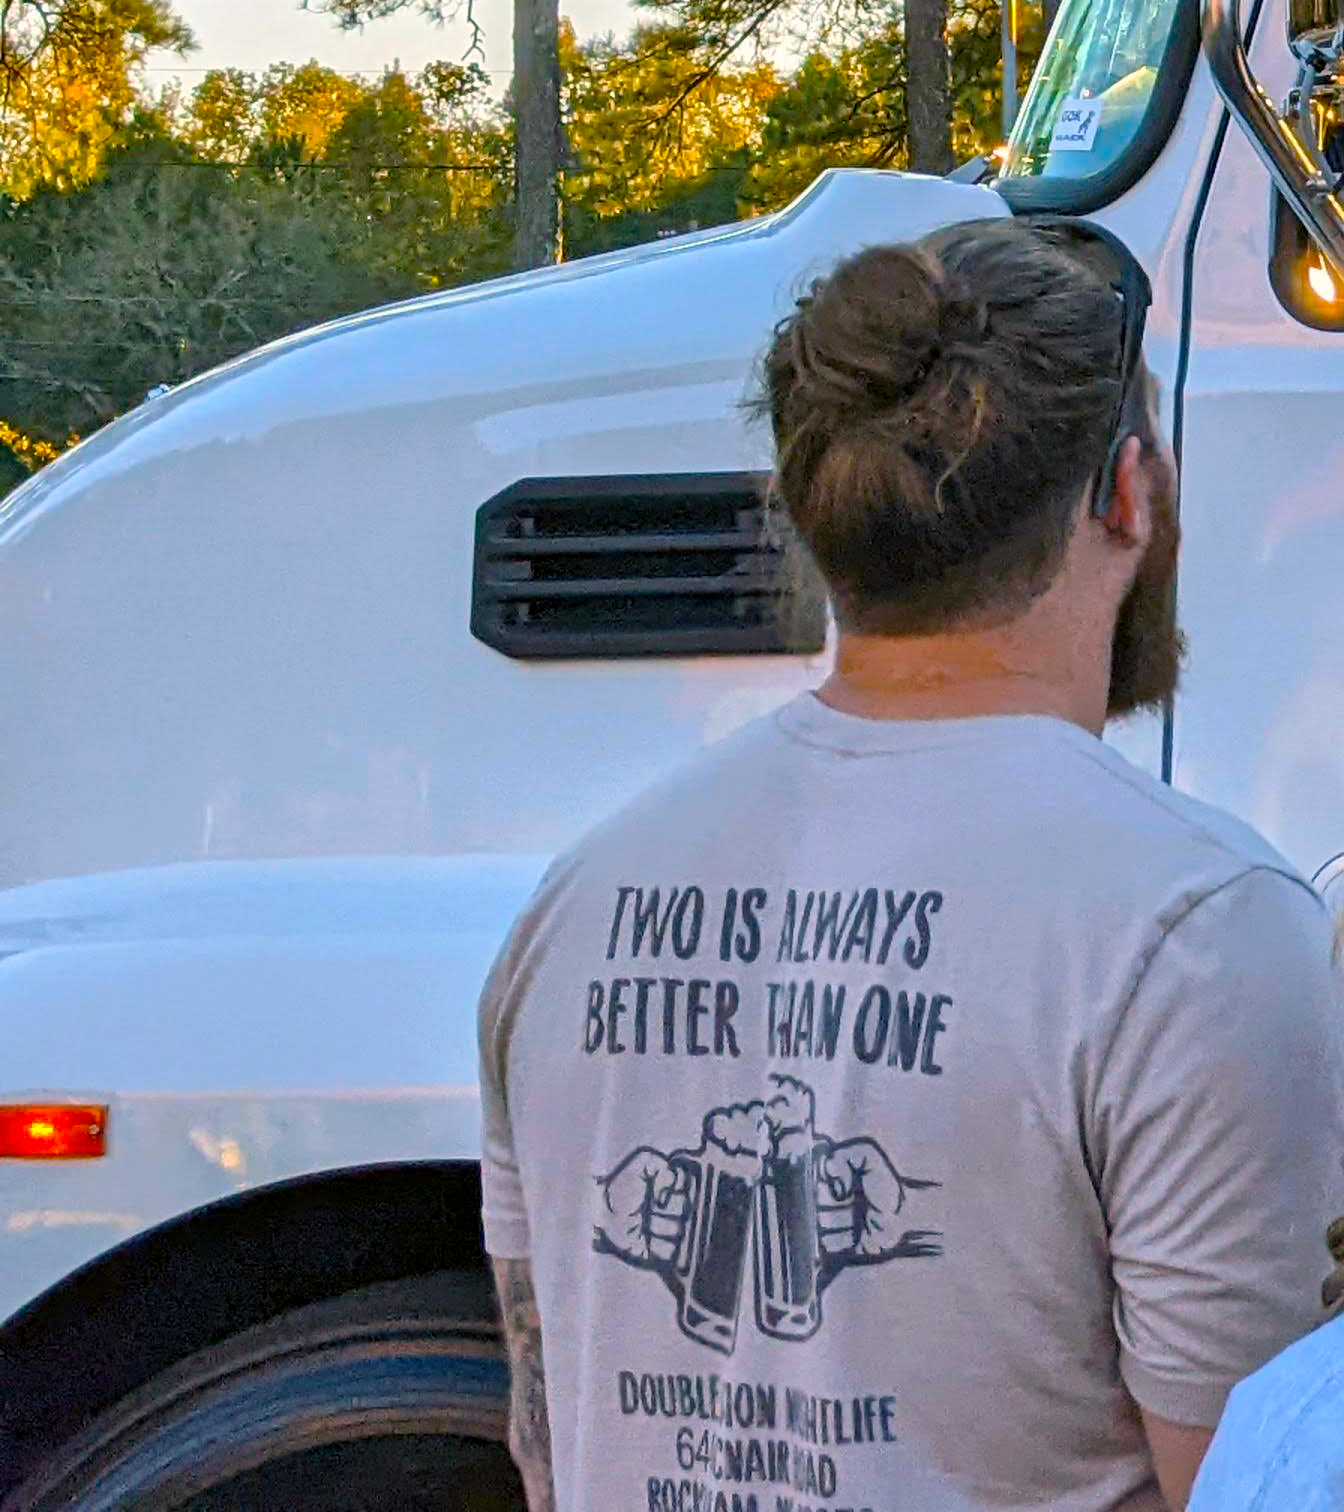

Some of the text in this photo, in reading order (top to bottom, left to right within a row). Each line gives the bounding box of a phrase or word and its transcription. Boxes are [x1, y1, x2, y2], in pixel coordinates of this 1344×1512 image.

[606, 886, 943, 970] TWO IS ALWAYS
[584, 978, 742, 1058] BETTER
[853, 985, 953, 1076] ONE
